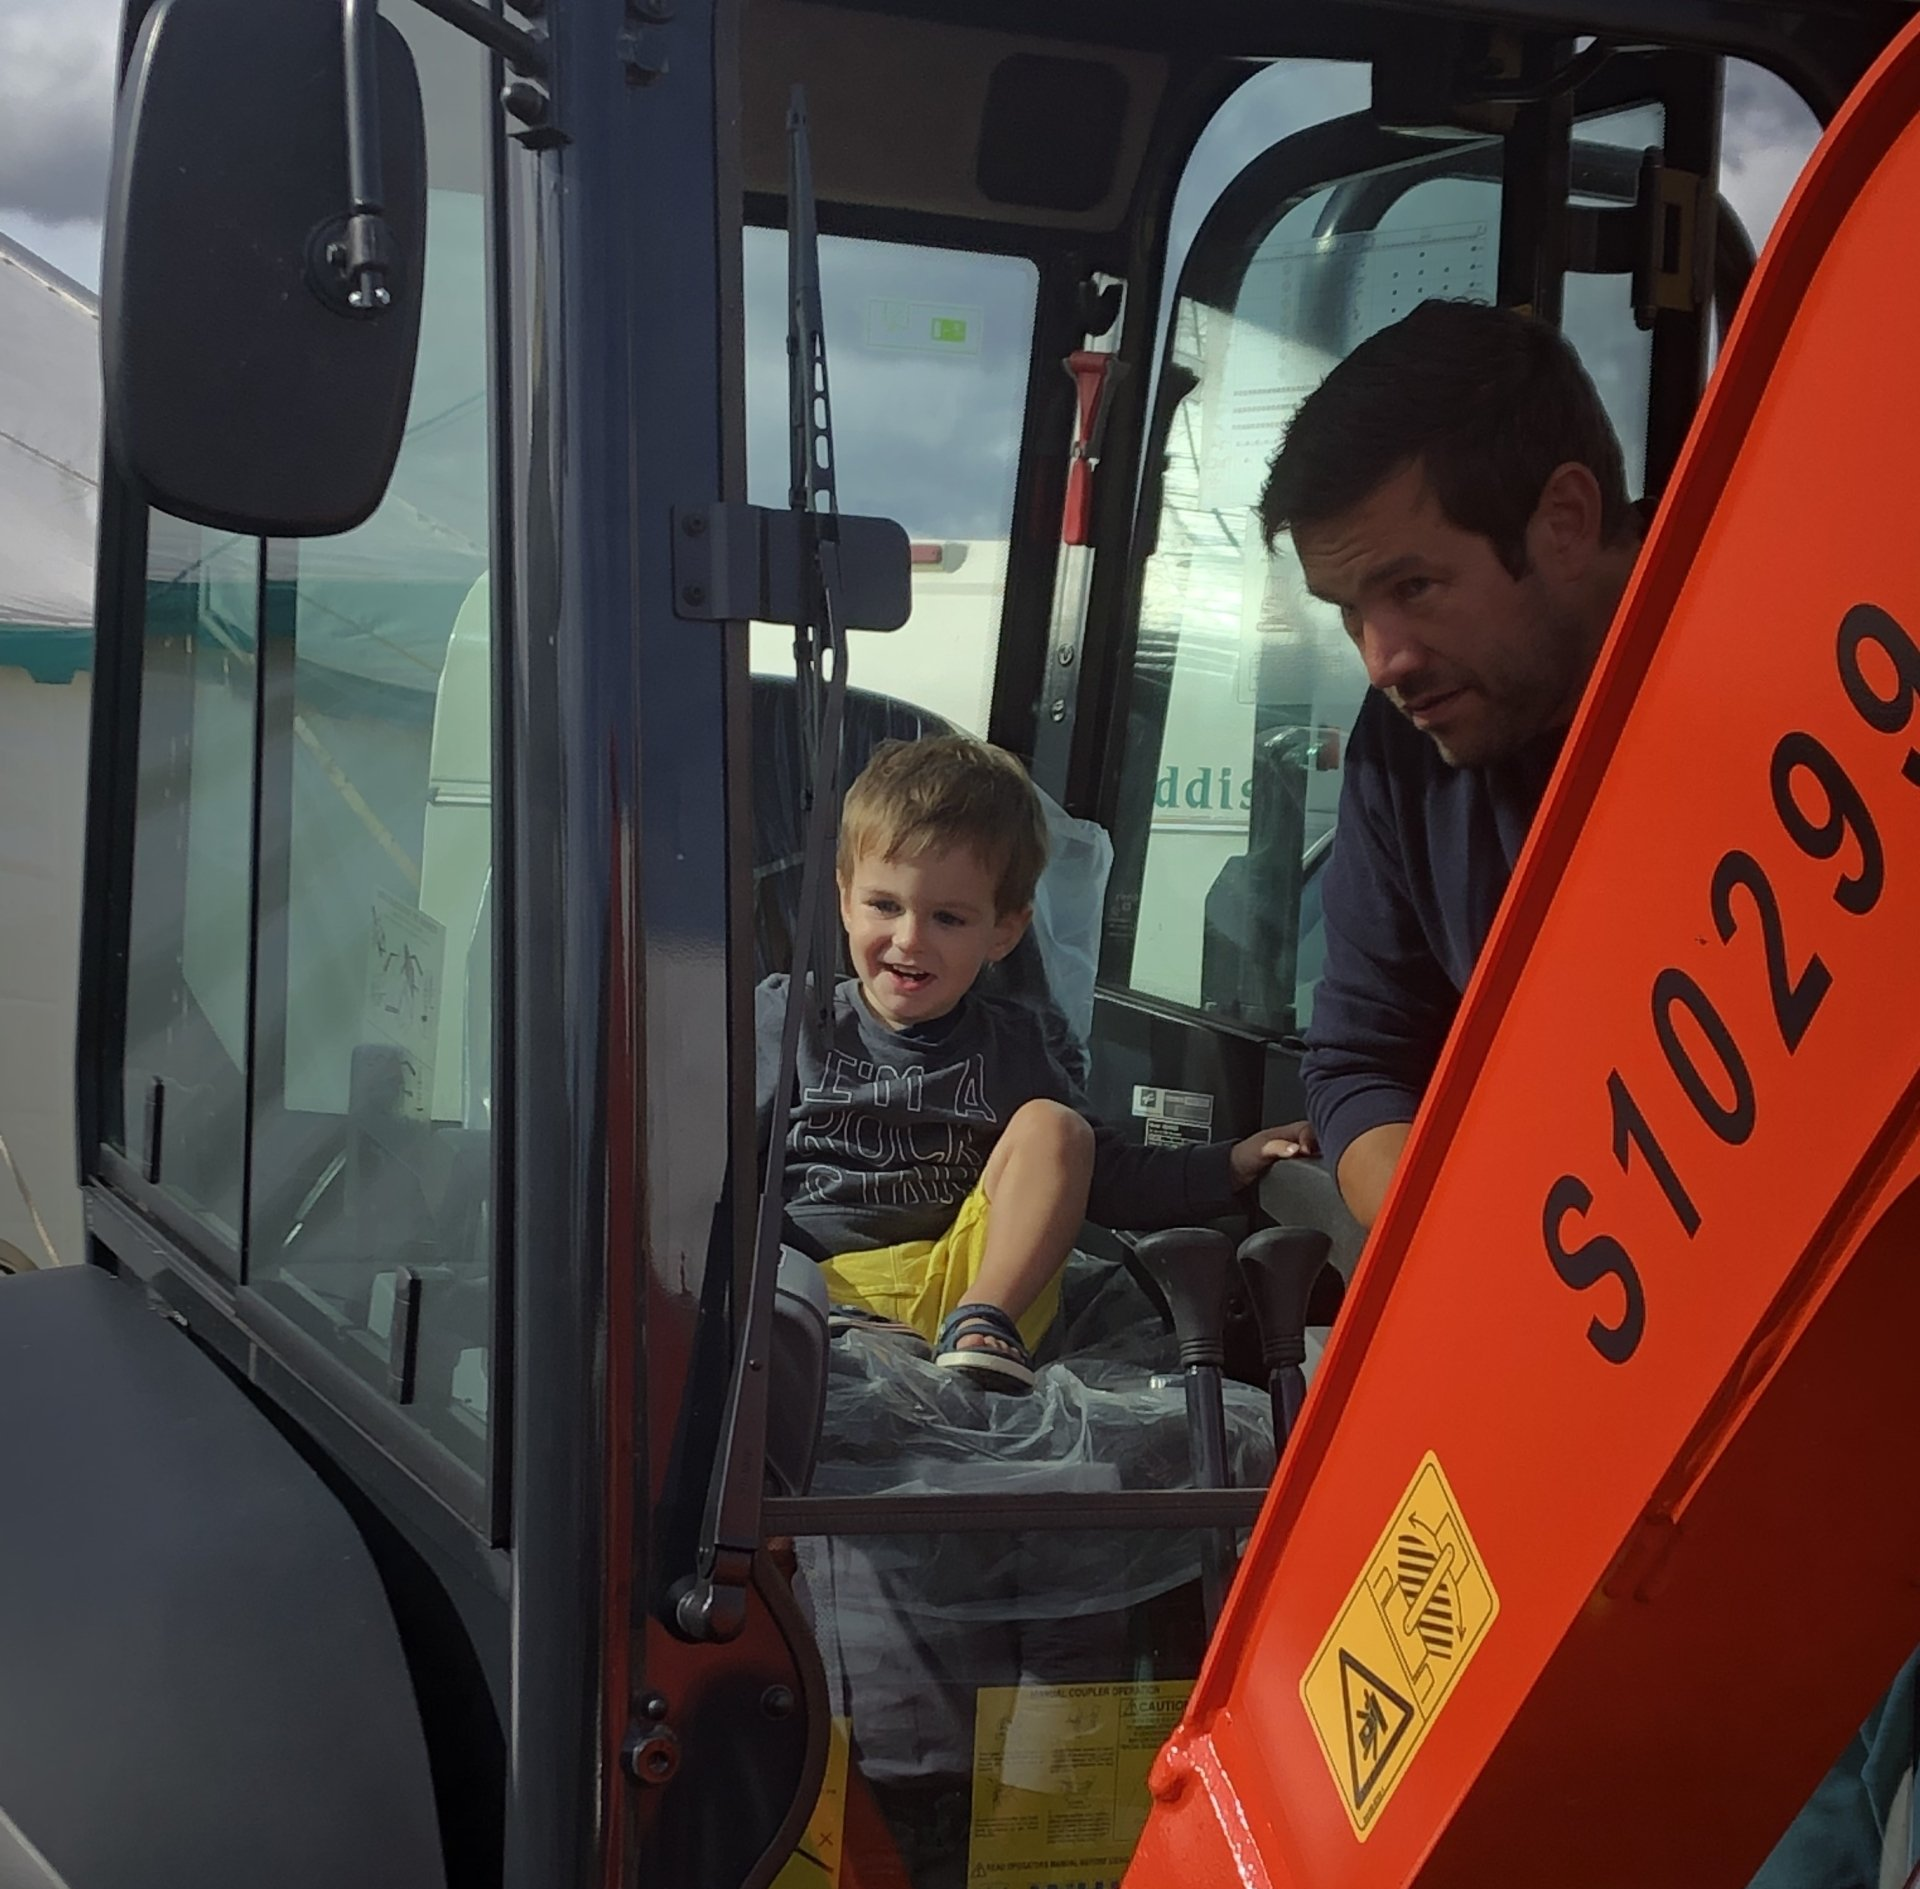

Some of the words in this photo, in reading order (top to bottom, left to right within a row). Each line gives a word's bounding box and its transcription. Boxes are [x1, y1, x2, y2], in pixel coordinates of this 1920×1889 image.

[1542, 603, 1920, 1364] S10299
[803, 1048, 925, 1112] I'M
[953, 1052, 999, 1124] A
[1068, 1687, 1110, 1698] COUPLER
